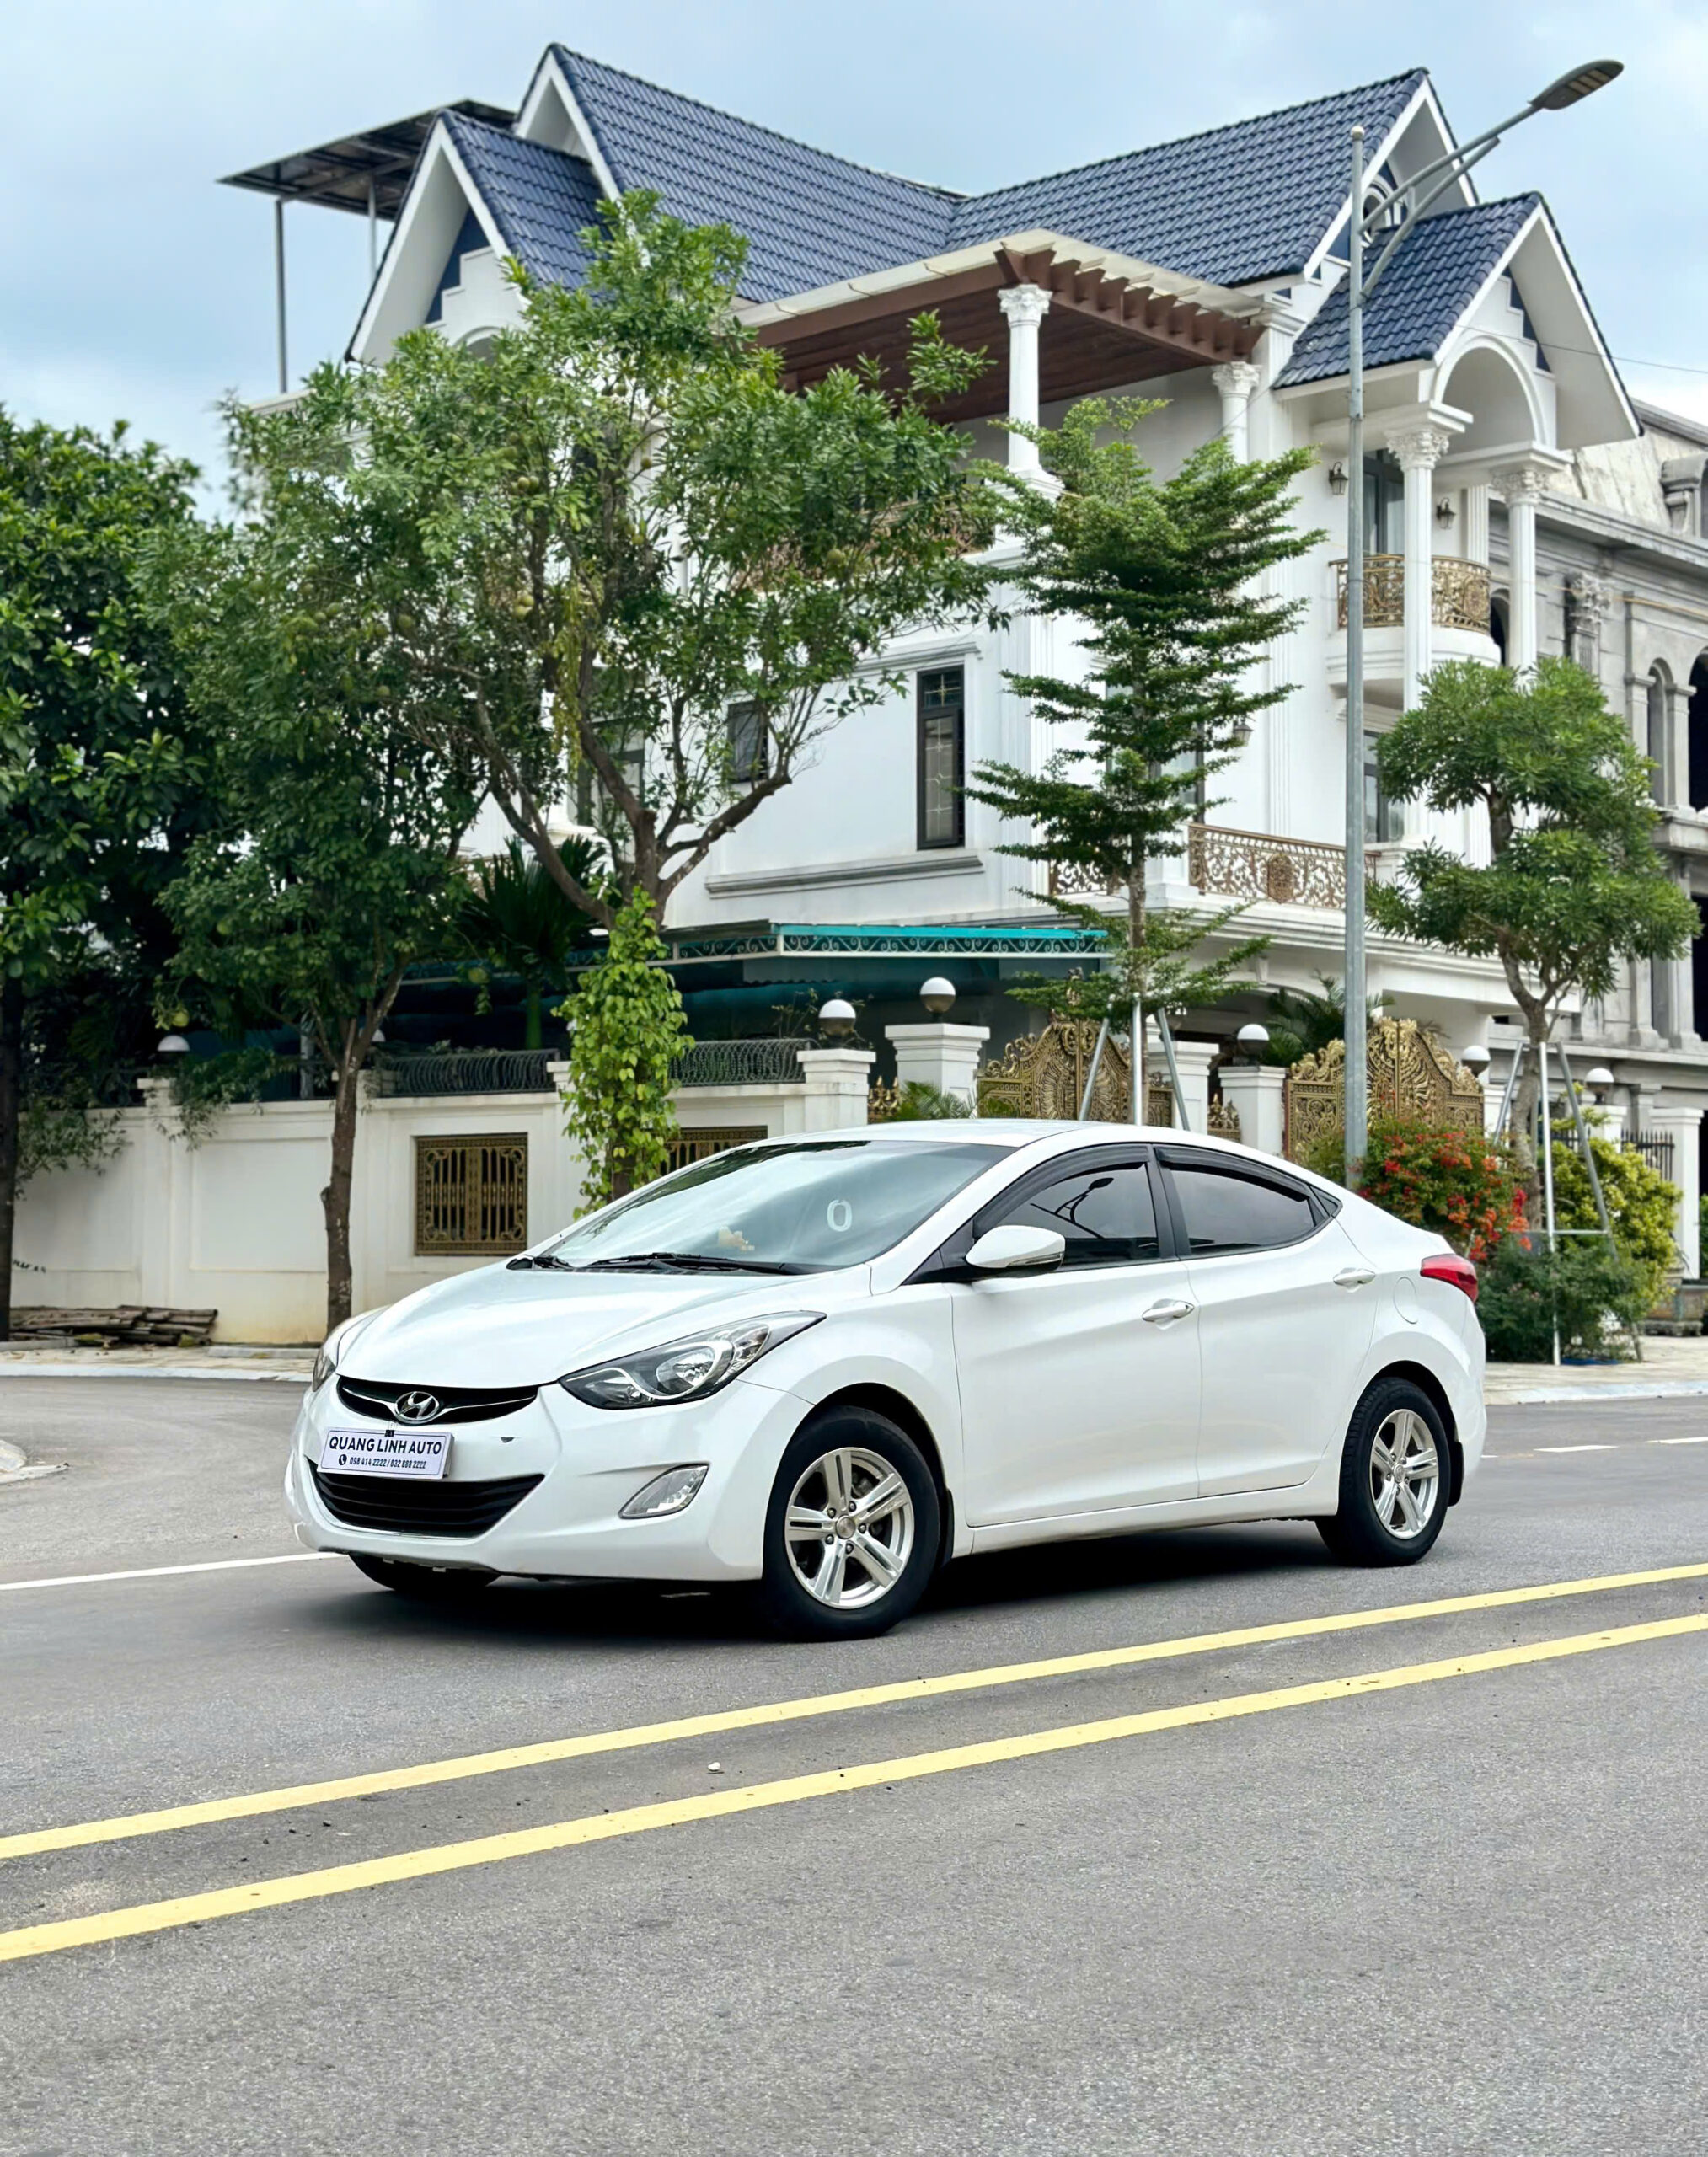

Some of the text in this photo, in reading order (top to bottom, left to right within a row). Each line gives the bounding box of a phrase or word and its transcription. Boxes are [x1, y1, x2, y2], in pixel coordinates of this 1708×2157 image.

[329, 1436, 442, 1455] QUANG LINH AUTO
[349, 1457, 361, 1465] 098
[372, 1459, 387, 1467] 2222
